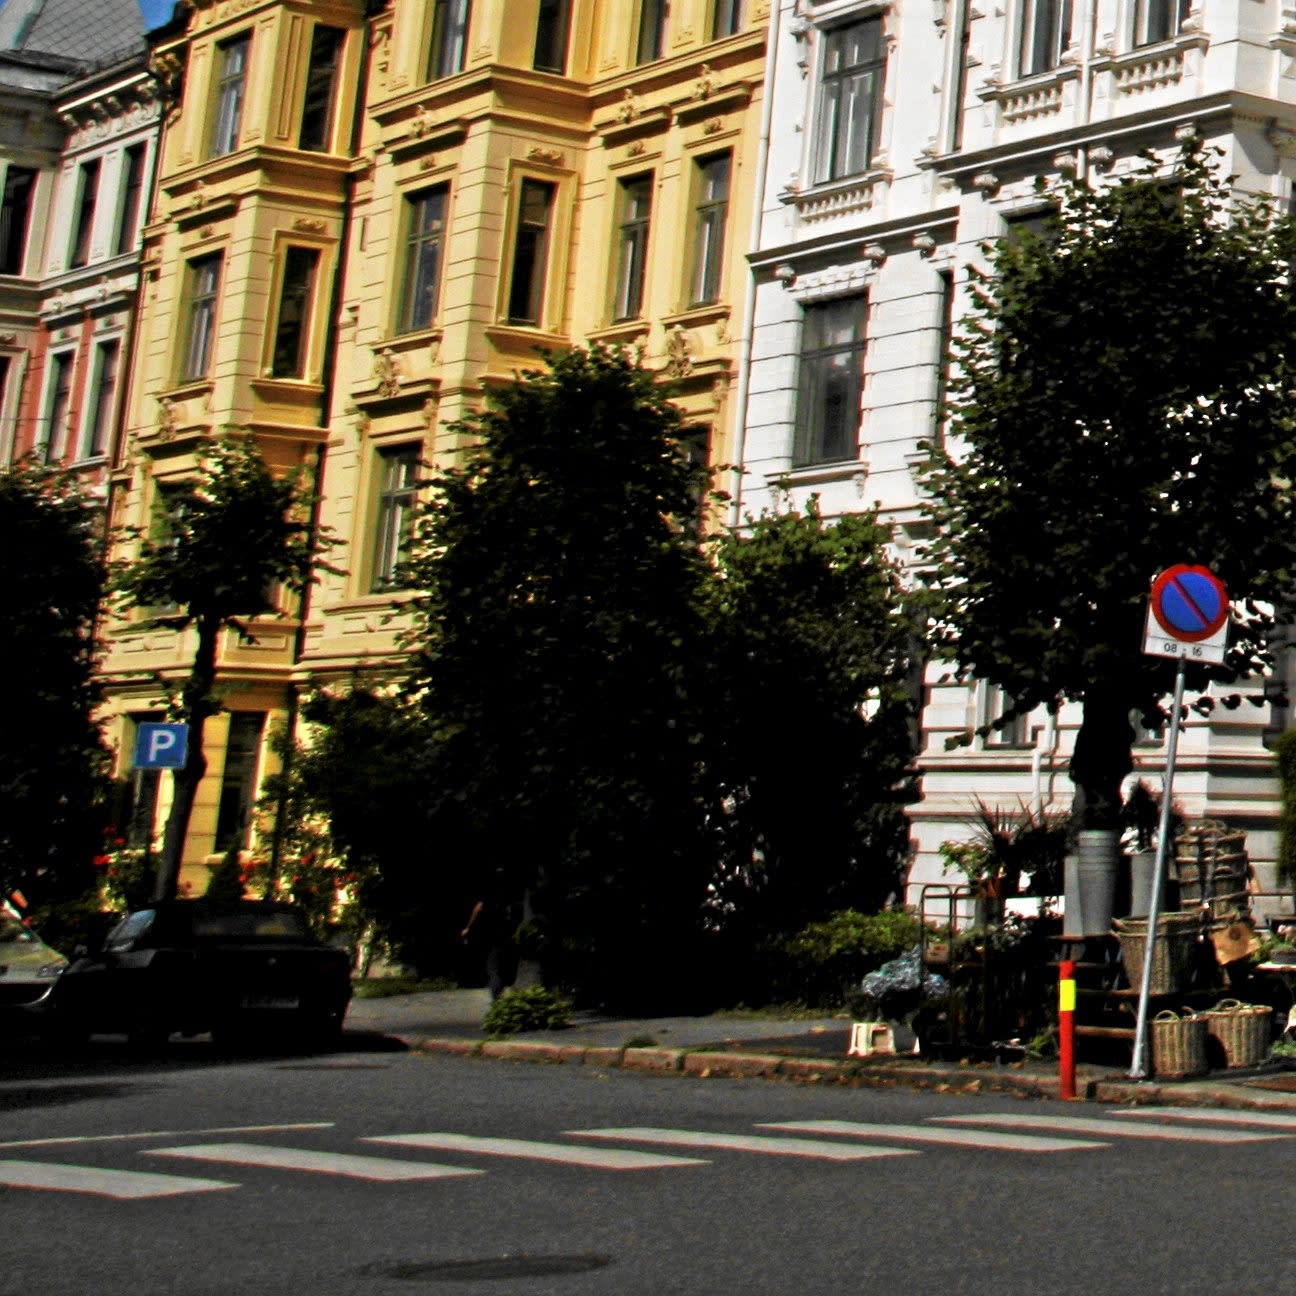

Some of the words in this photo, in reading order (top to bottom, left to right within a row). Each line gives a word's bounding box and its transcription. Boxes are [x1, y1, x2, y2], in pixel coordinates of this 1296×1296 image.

[1163, 642, 1178, 653] 08
[1192, 646, 1203, 657] 16
[149, 730, 176, 762] P
